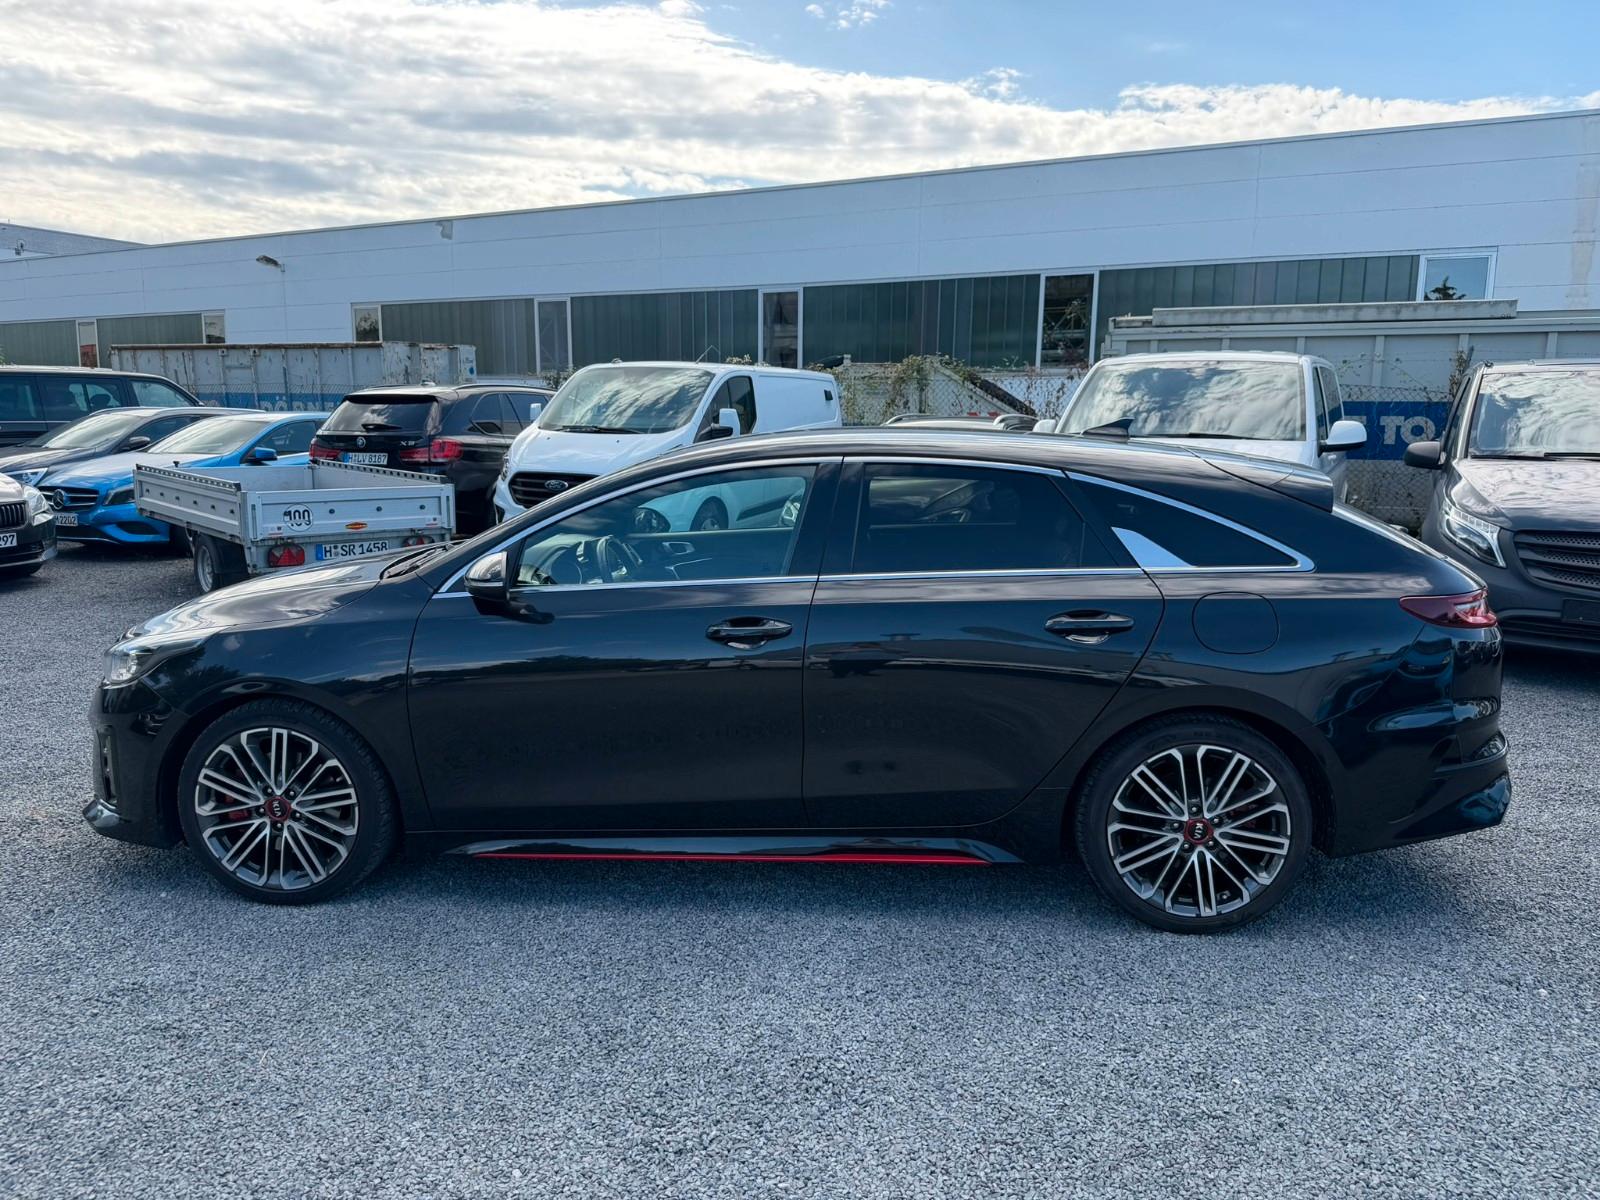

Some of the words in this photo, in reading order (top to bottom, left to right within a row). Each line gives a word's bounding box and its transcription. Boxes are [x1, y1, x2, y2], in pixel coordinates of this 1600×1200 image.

[0, 534, 15, 546] 97
[324, 545, 333, 558] H
[340, 543, 356, 557] SR
[359, 541, 388, 555] 1458
